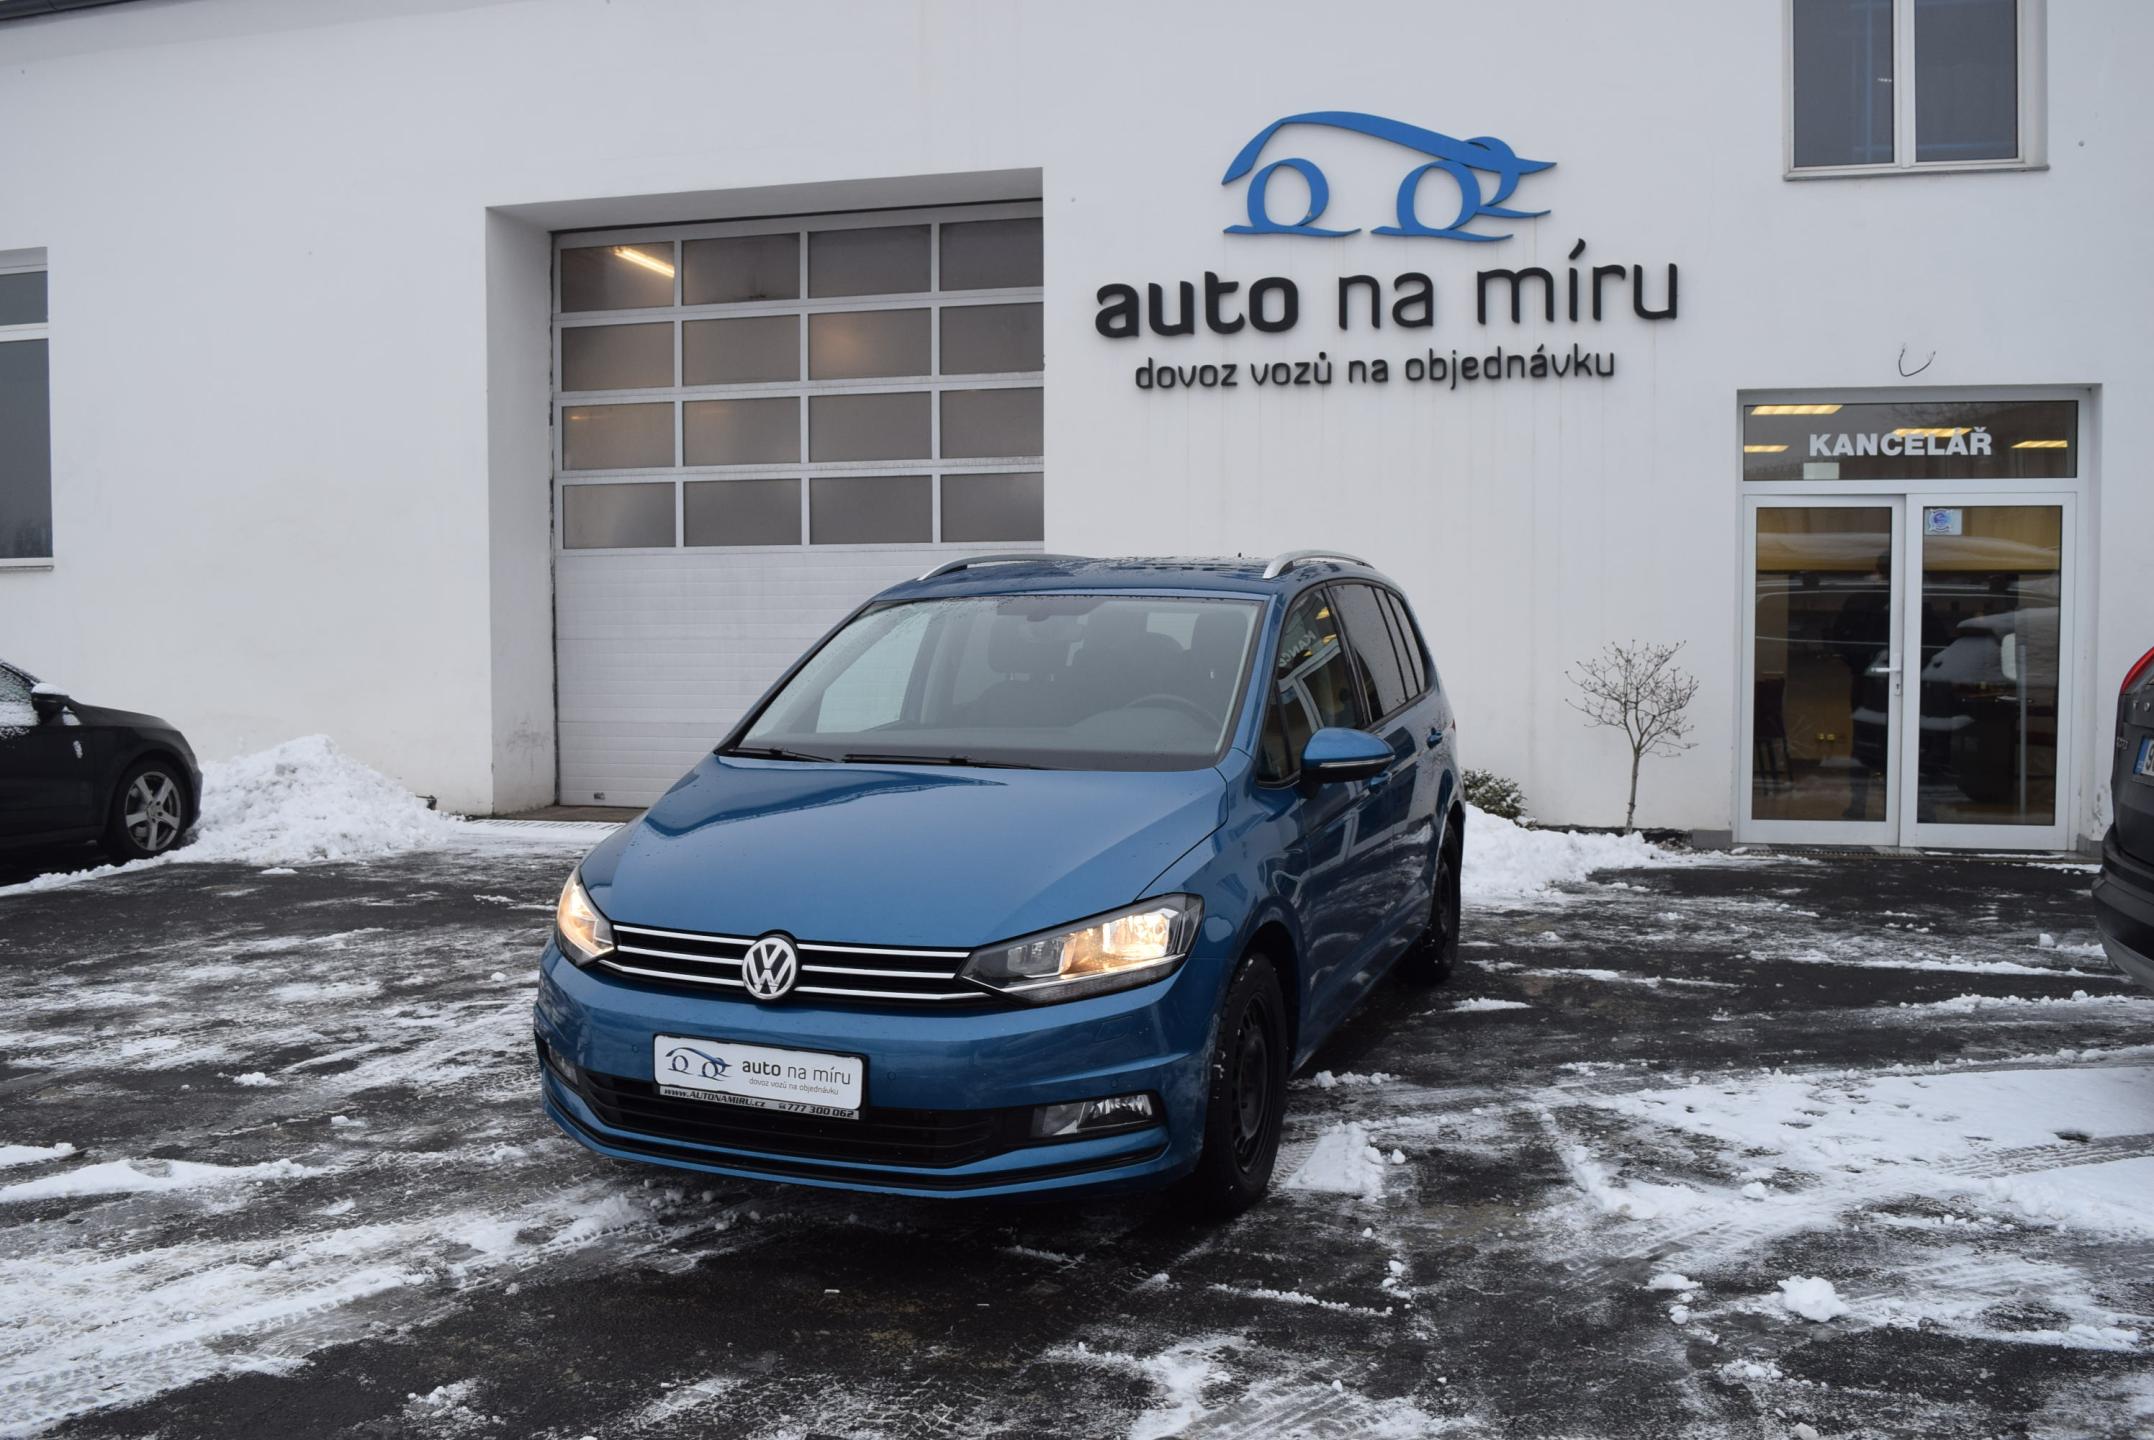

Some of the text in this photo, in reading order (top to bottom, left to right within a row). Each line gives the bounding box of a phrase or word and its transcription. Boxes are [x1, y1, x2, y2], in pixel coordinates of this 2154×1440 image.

[1095, 238, 1678, 340] auto na míru
[1134, 342, 1616, 391] dovoz vozů na objednávku
[1809, 426, 1993, 457] KANCELÁŘ
[745, 940, 794, 997] VW
[742, 1060, 851, 1085] auto na míru
[749, 1077, 769, 1087] dovoz
[799, 1083, 839, 1095] objednávku
[787, 1103, 807, 1112] 777
[809, 1105, 831, 1115] 300
[832, 1108, 854, 1118] 062
